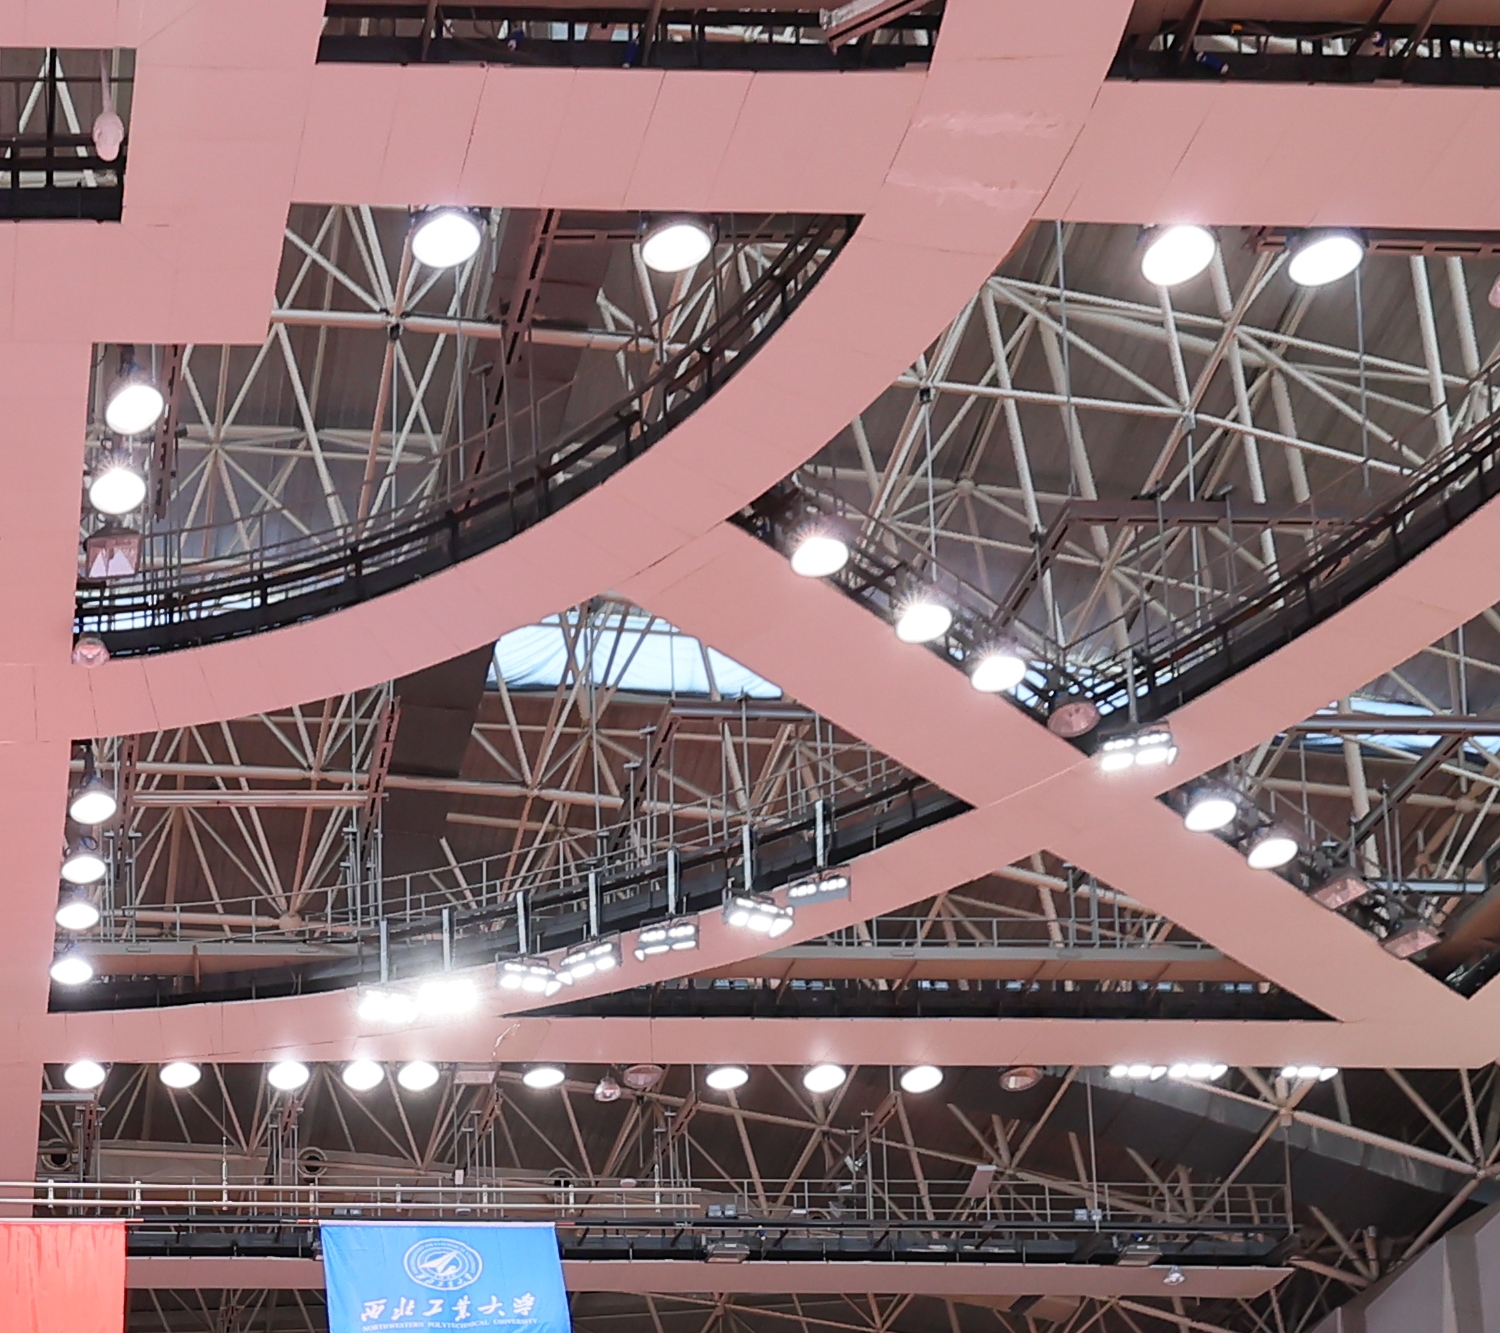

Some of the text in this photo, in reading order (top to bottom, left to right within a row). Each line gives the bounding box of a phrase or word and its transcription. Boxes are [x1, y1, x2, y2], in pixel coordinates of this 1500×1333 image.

[362, 1318, 539, 1332] NORTHWESTERN POLYTECHNICAL UNIVERSITY
